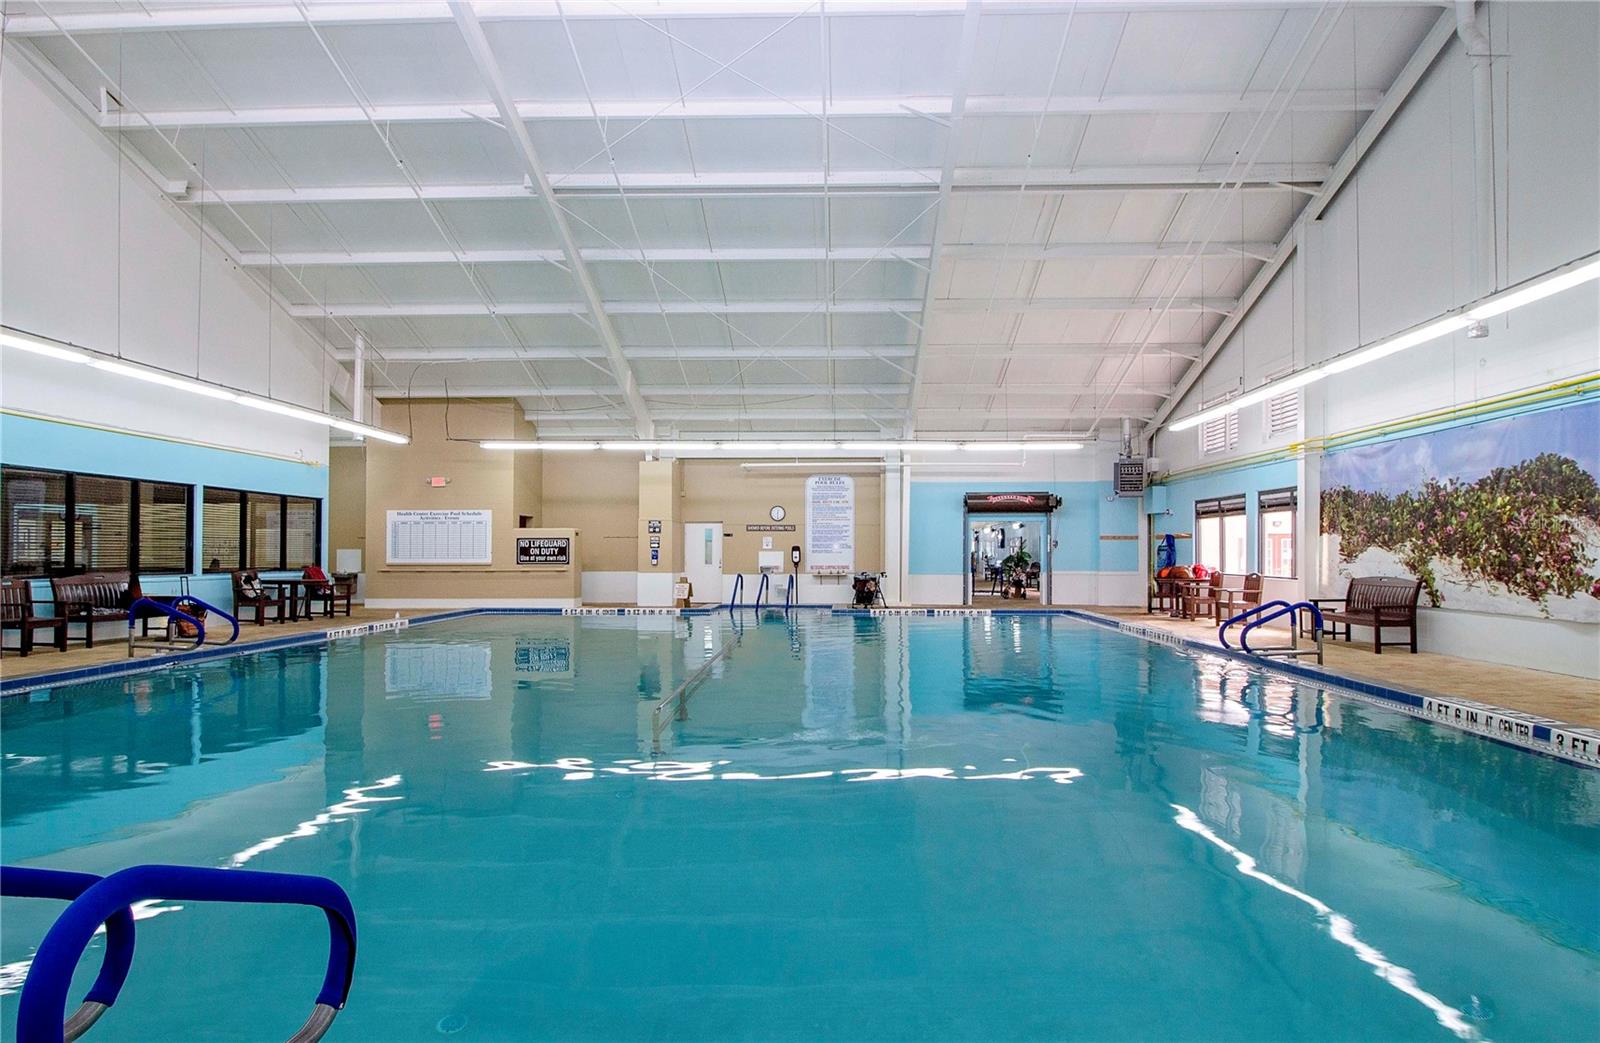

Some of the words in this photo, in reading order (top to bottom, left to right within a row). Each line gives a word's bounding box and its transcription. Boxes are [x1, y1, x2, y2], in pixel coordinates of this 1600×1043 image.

[1426, 701, 1433, 712] 4
[1437, 703, 1450, 716] FT
[1454, 708, 1461, 719] 6
[1466, 710, 1478, 724] IN
[1485, 715, 1493, 728] AT
[1498, 718, 1529, 737] CENTER
[1556, 733, 1564, 747] 3
[1571, 737, 1589, 753] FT
